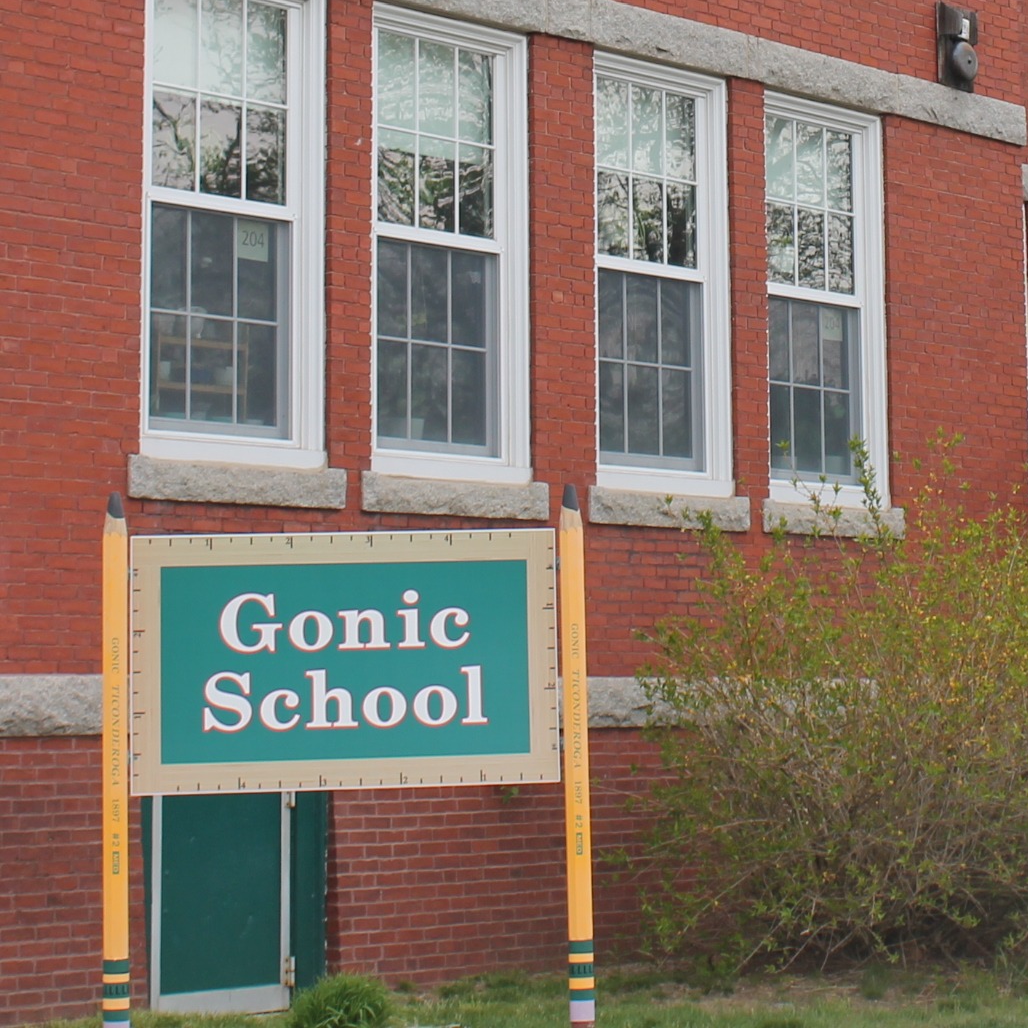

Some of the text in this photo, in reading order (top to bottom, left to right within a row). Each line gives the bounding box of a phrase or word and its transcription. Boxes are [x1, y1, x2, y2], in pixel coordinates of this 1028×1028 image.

[242, 230, 265, 248] 204
[218, 588, 471, 654] Gonic
[111, 637, 120, 674] GONIC
[571, 623, 580, 659] GONIC
[202, 664, 489, 734] School
[111, 685, 120, 786] TICONDEROGA
[572, 669, 582, 768] TICONDEROGA
[112, 798, 120, 822] 1897
[574, 781, 582, 804] 1897
